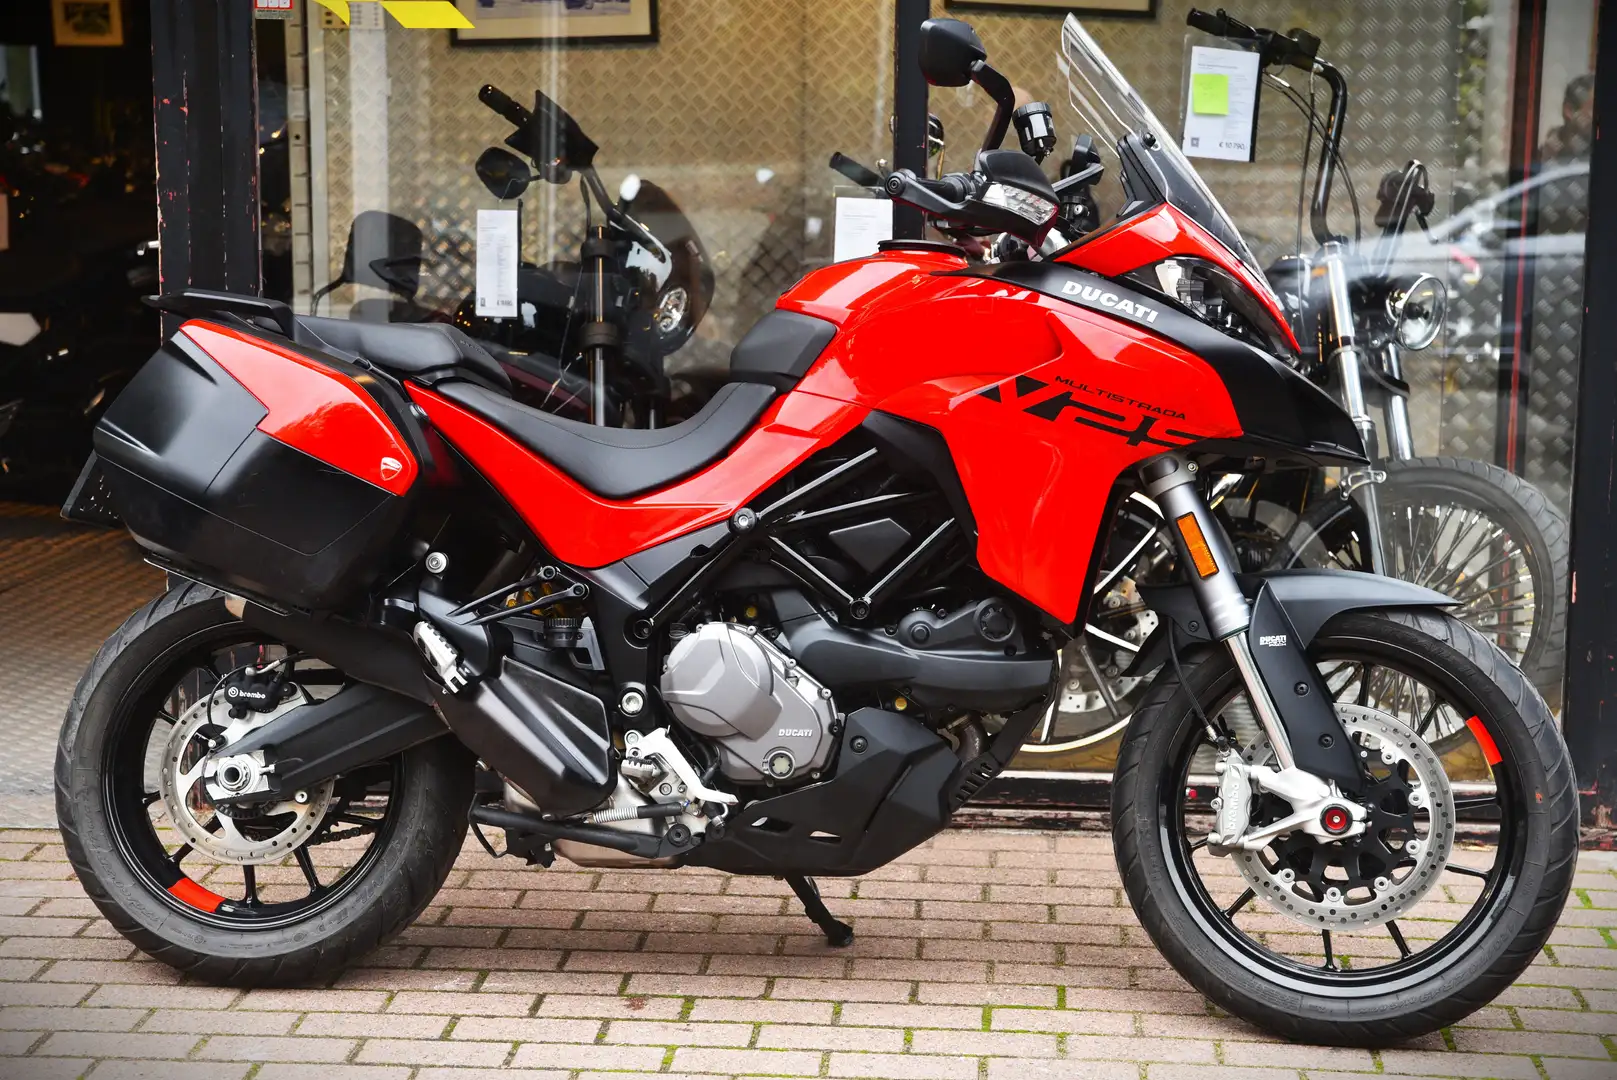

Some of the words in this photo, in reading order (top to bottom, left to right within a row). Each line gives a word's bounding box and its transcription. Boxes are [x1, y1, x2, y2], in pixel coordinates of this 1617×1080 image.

[1061, 280, 1159, 324] DUCATI
[1054, 375, 1187, 421] MULTISTRADA
[239, 689, 266, 699] brembo
[778, 729, 813, 737] DUCATI
[1226, 783, 1239, 831] brembo
